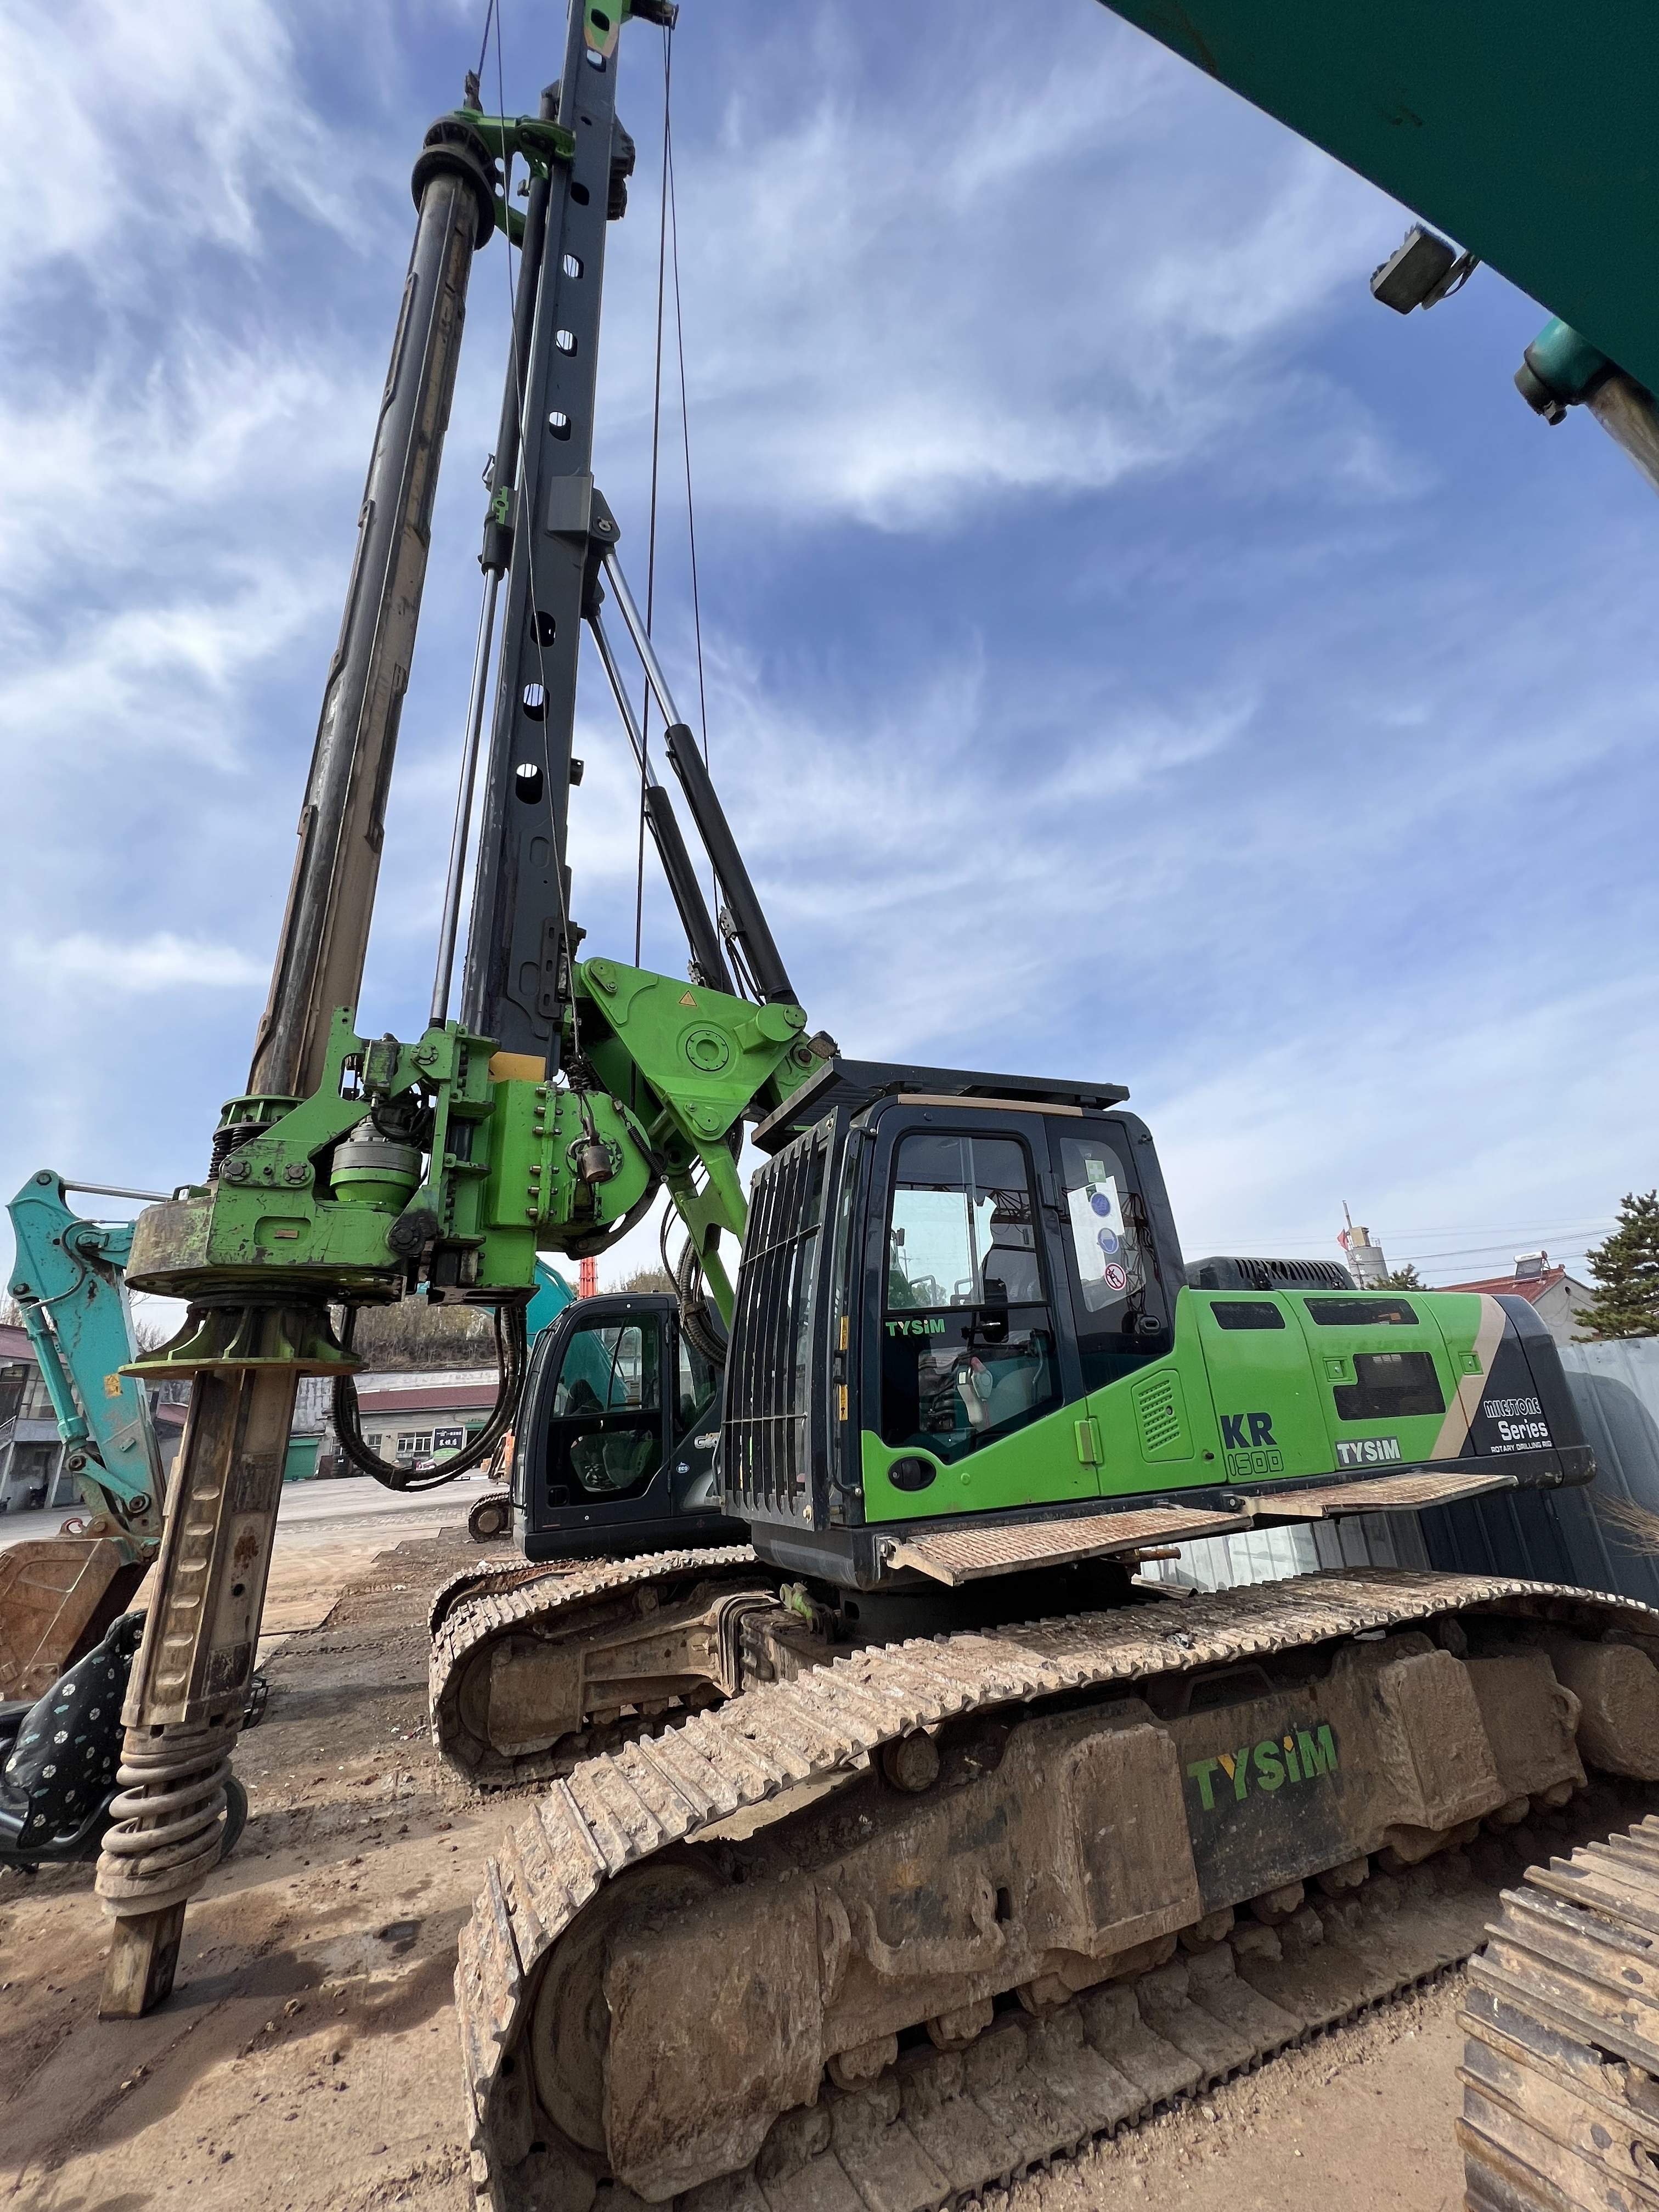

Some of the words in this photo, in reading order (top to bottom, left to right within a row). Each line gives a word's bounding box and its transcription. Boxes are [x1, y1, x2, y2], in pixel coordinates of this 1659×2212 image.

[1220, 1412, 1278, 1449] KR
[1498, 1418, 1548, 1441] Series
[1491, 1444, 1514, 1453] ROTARY
